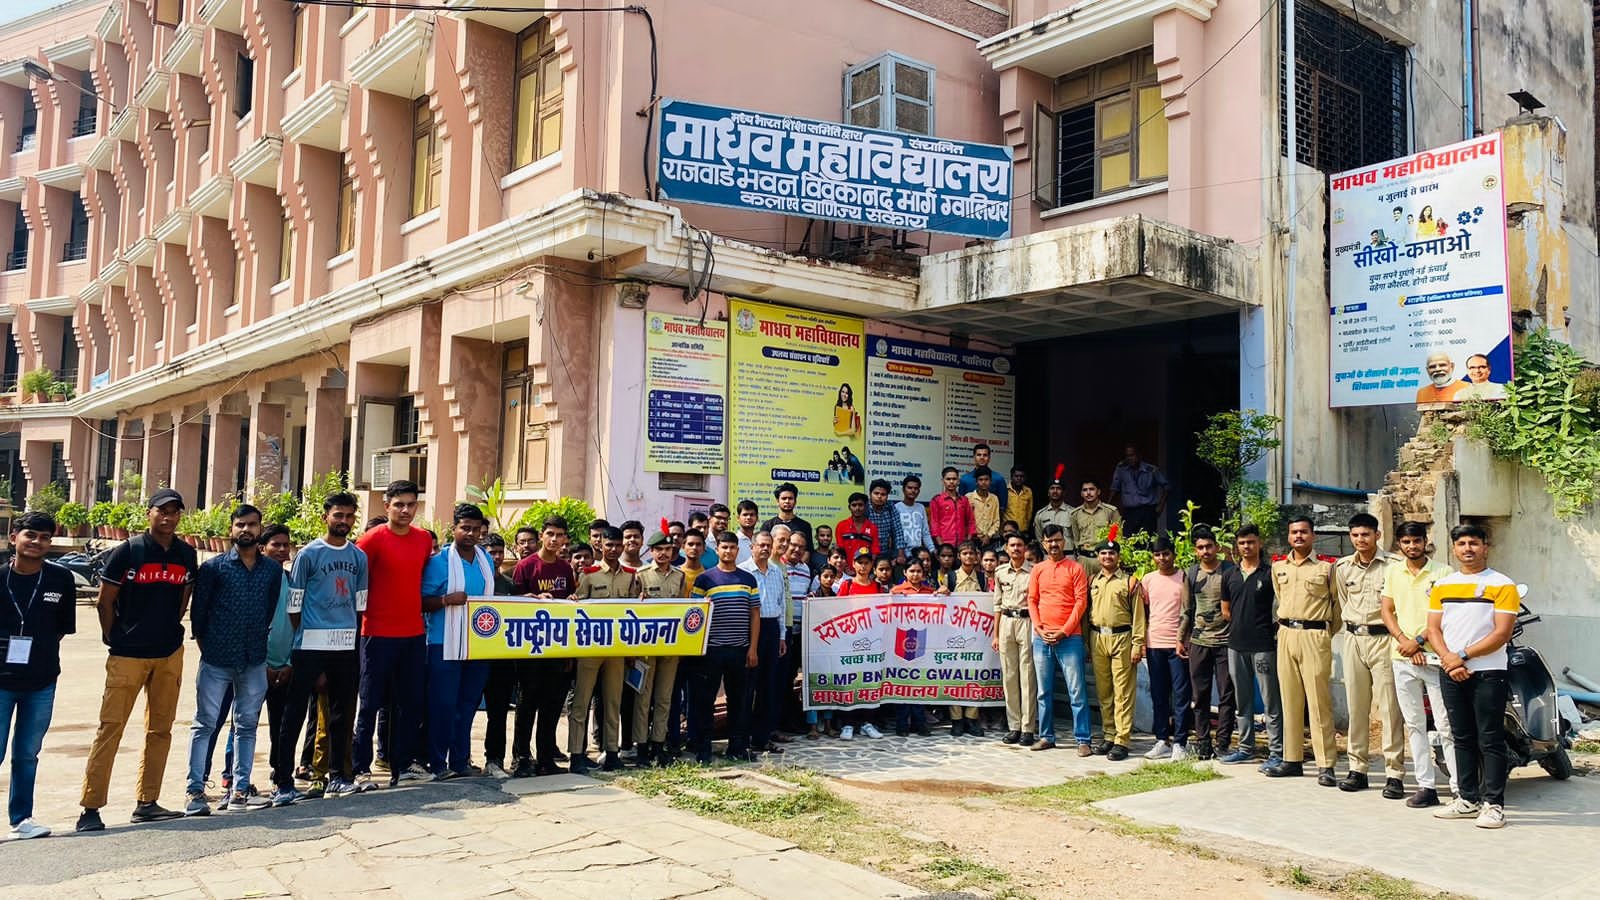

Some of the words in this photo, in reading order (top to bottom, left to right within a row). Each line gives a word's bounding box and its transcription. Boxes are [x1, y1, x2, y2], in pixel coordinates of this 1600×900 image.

[665, 113, 786, 169] माधव
[786, 134, 1010, 196] महाविद्यालय
[1332, 169, 1378, 191] माधव
[1382, 139, 1496, 178] महाविद्यालय
[736, 167, 799, 196] भवन
[896, 186, 937, 214] मार्ग
[940, 193, 1009, 222] ग्वालियर
[740, 191, 784, 210] कला
[801, 199, 861, 219] वाणिज्य
[1385, 187, 1408, 203] जुलाई
[1335, 241, 1361, 256] मुख्यमंत्री
[1353, 229, 1472, 268] सीखो-कमाओ
[664, 322, 683, 334] माधव
[685, 323, 726, 338] महाविद्यालय
[759, 319, 792, 339] माधव
[794, 324, 860, 348] महाविद्यालय
[891, 345, 913, 356] माधव
[321, 560, 358, 576] YANKEES
[504, 610, 570, 654] राष्ट्रीय
[574, 609, 614, 646] सेवा
[618, 609, 681, 645] योजना
[813, 608, 873, 645] स्वच्छता
[875, 603, 948, 625] जागरूकता
[950, 600, 995, 637] अभिया
[328, 630, 355, 647] YANKEE
[934, 652, 957, 665] सुन्दर
[960, 652, 984, 661] भारत
[817, 674, 828, 685] 8
[833, 672, 858, 685] MP
[862, 671, 883, 683] BN
[885, 667, 921, 680] NCC
[926, 668, 1001, 681] GWALIOR
[812, 690, 855, 705] माधव
[943, 683, 1004, 700] ग्वालियर
